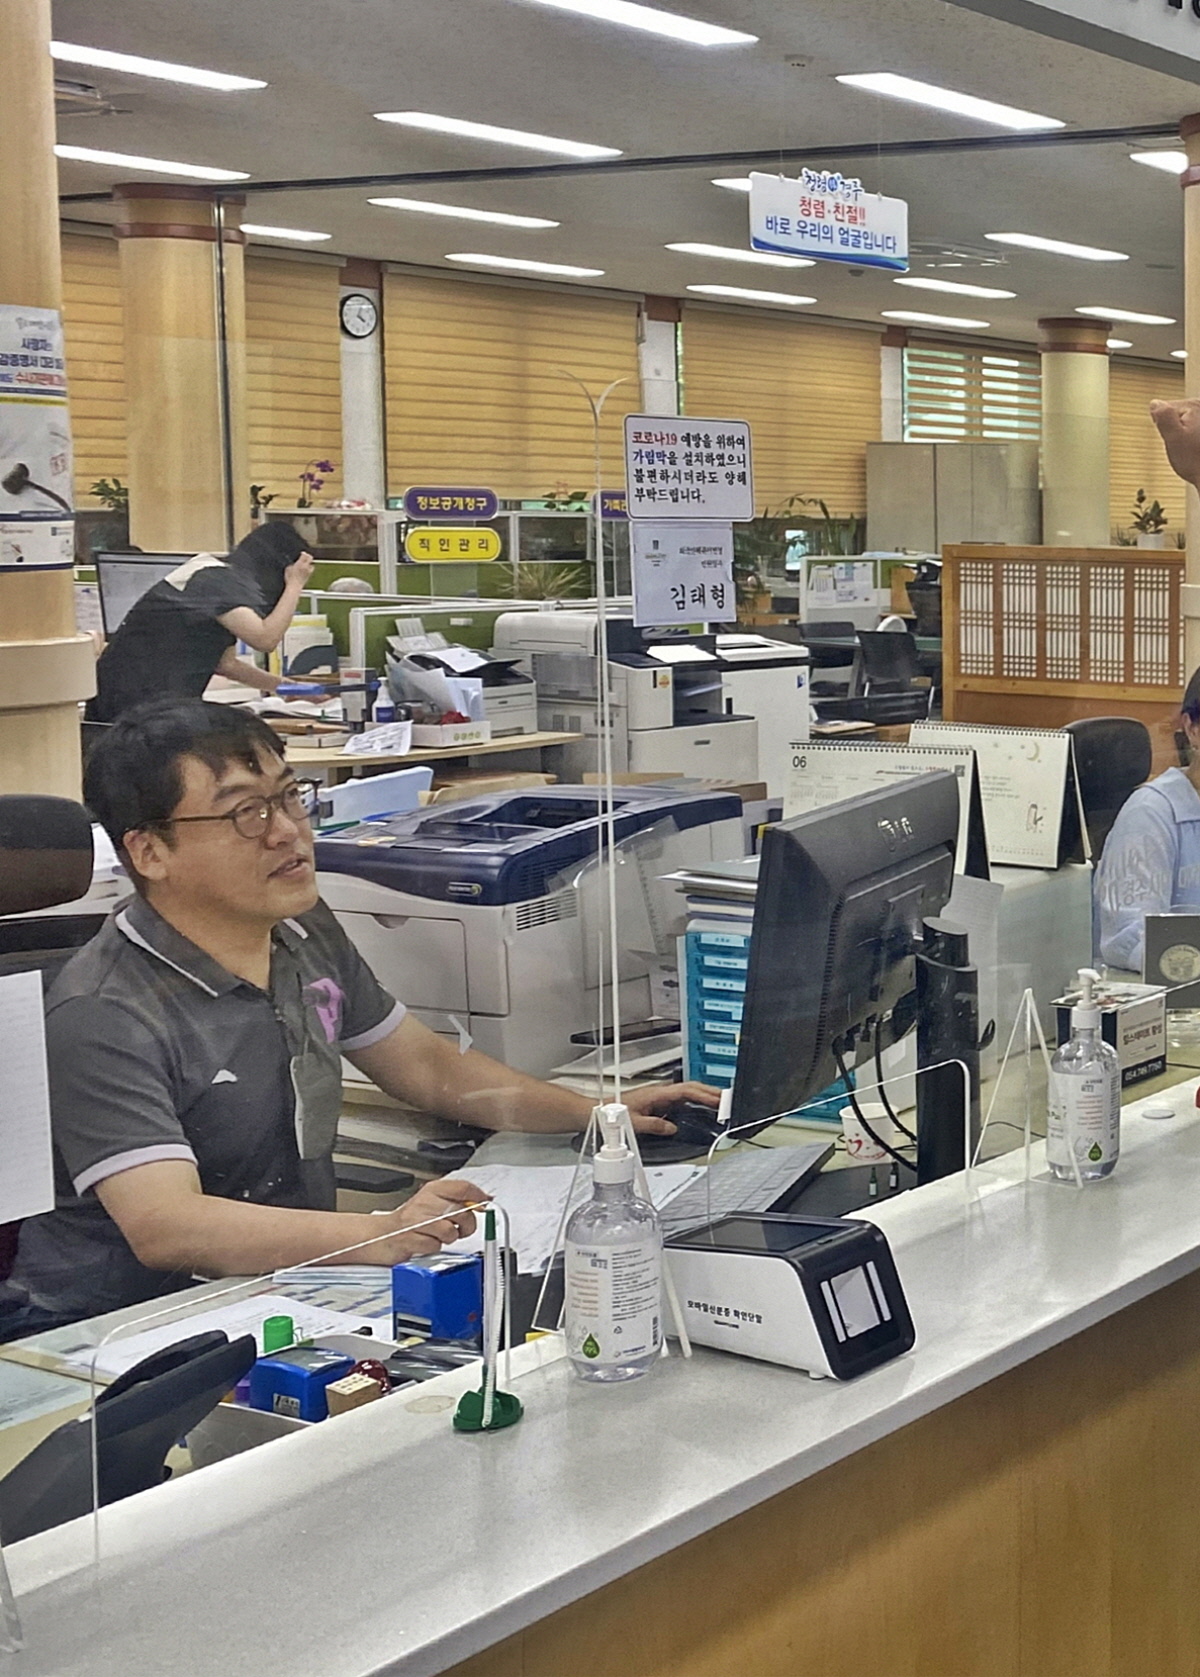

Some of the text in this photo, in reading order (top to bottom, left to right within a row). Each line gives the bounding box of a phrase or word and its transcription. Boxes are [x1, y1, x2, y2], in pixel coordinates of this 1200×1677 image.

[765, 215, 897, 254] 바로 우리의 얼굴입니다
[631, 431, 746, 451] 코로나19 예방을 위하여
[632, 449, 746, 468] 가림막을 설치하였으니
[633, 468, 747, 487] 불편하시더라도 양해
[417, 496, 488, 512] 정보공개청구
[634, 487, 706, 504] 부탁드립니다.
[670, 583, 725, 611] 김태형
[792, 756, 807, 769] 06
